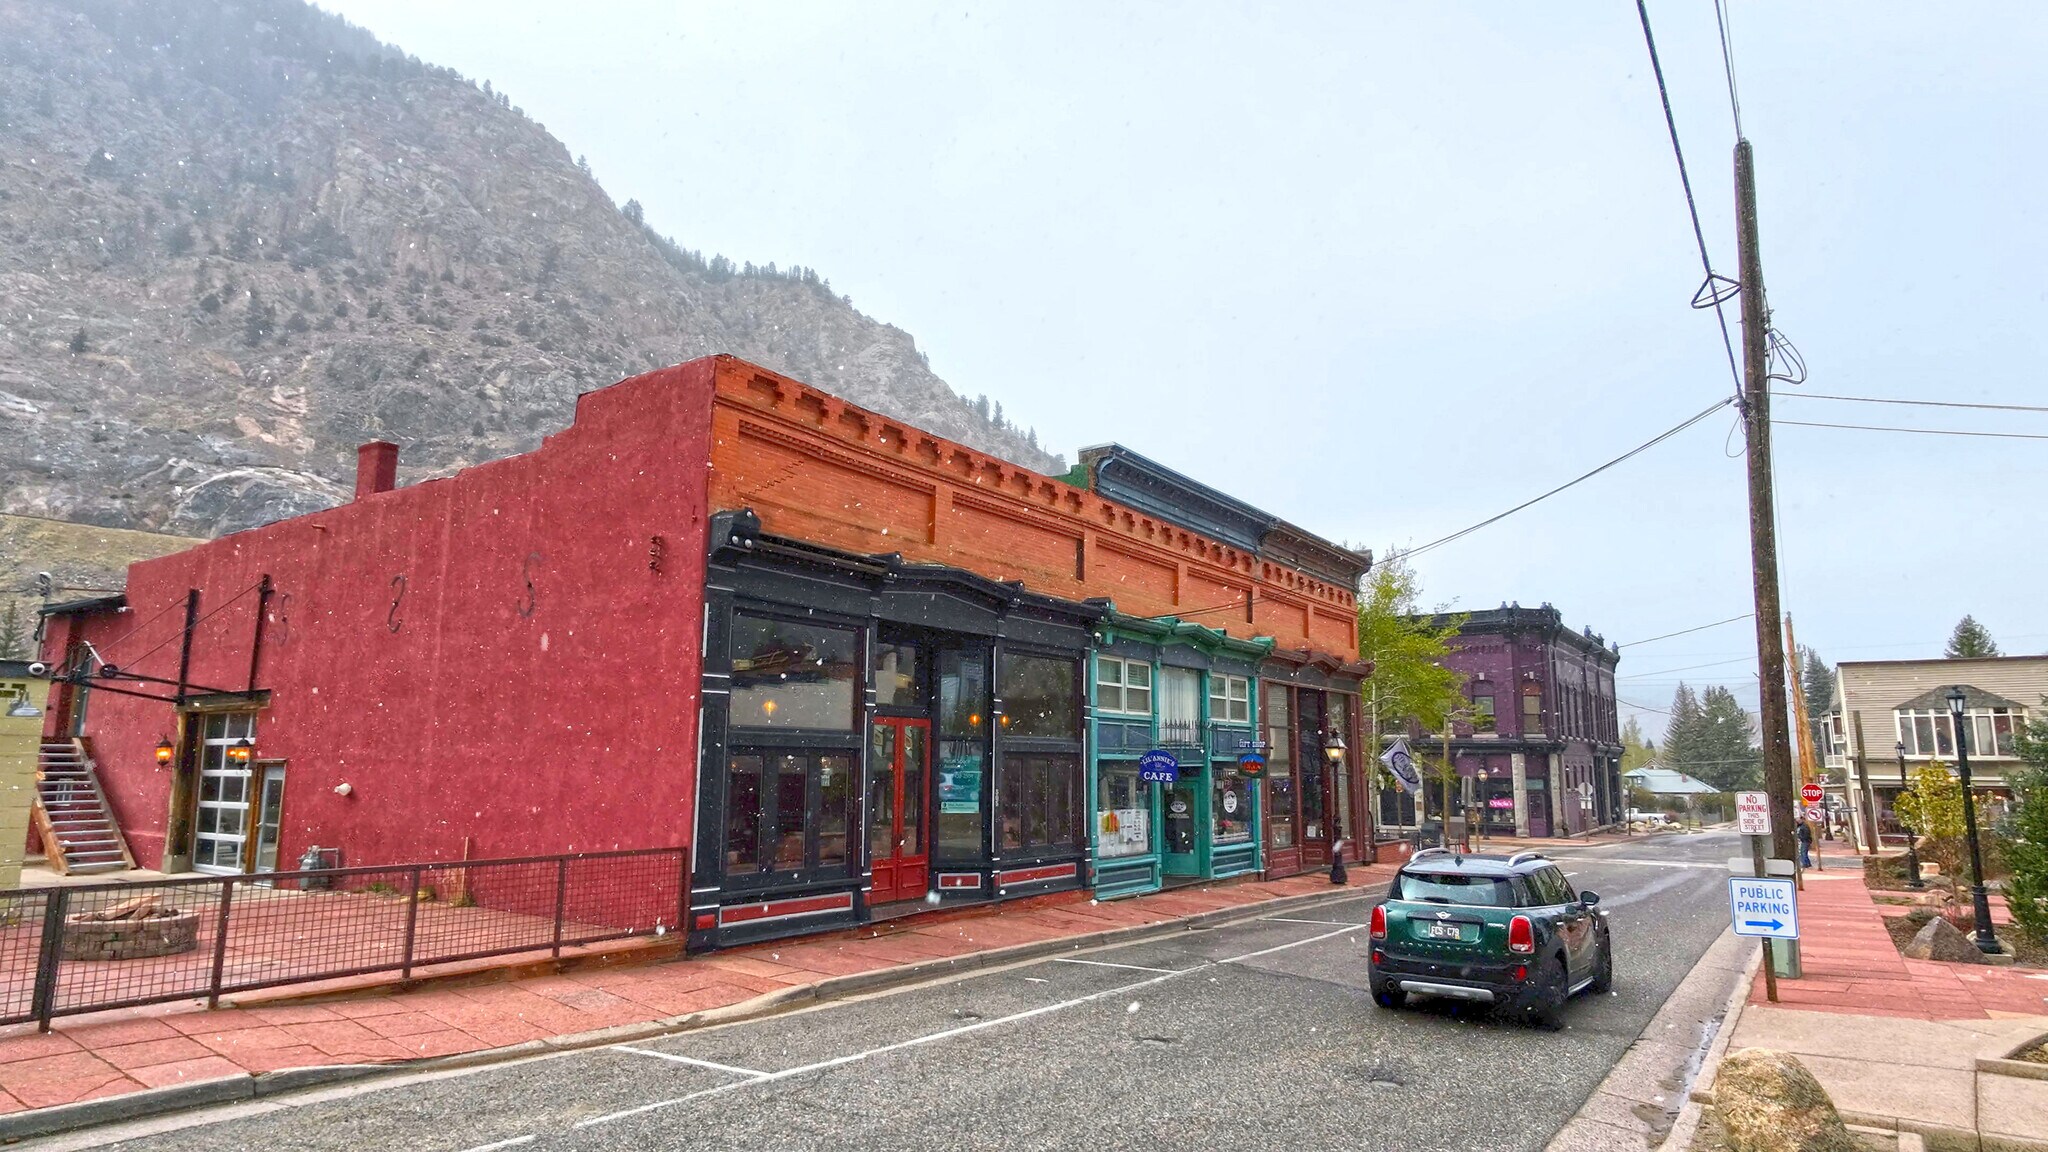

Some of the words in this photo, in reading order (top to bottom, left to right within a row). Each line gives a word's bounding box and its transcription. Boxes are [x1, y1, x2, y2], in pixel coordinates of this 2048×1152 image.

[1143, 771, 1173, 782] CAFE
[1802, 789, 1823, 797] STOP
[1745, 796, 1758, 804] NO
[1739, 805, 1767, 813] PARKING
[1739, 887, 1784, 900] PUBLIC
[1737, 901, 1790, 915] PARKING
